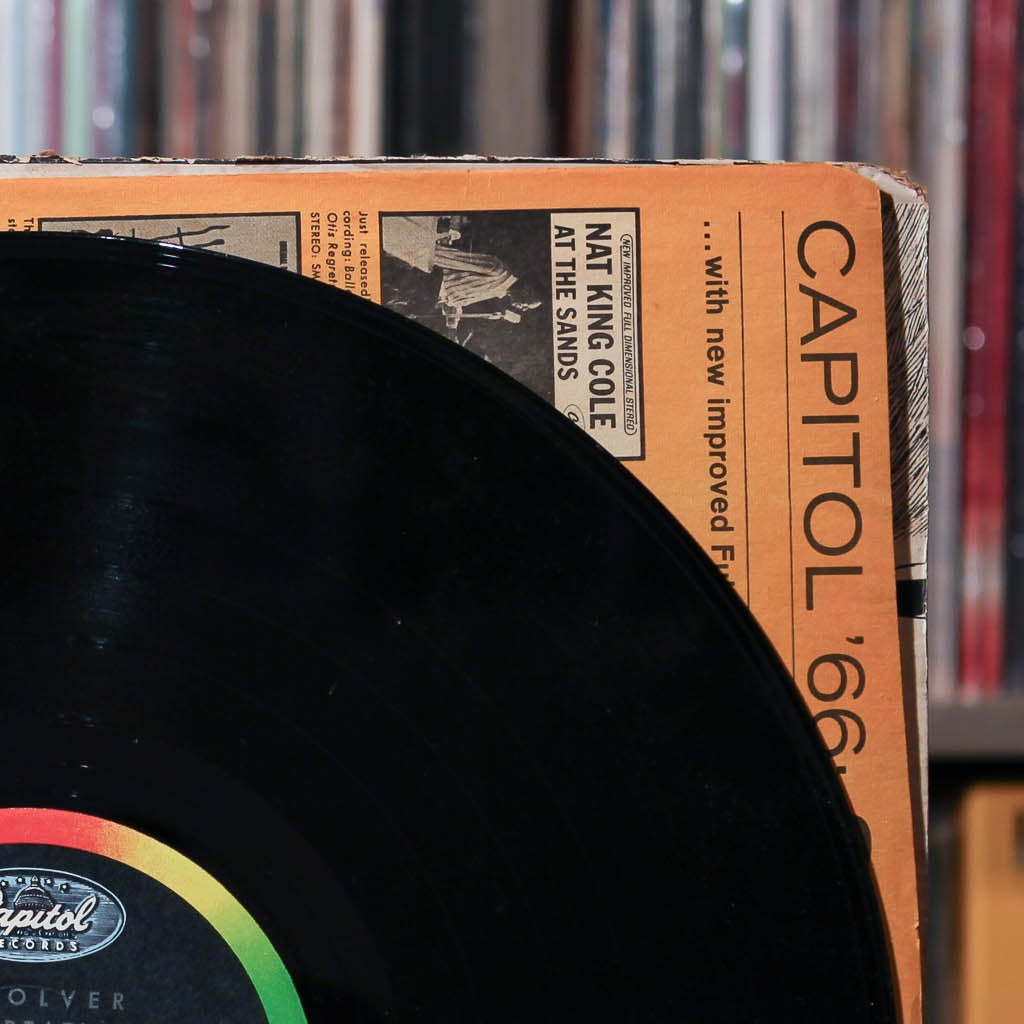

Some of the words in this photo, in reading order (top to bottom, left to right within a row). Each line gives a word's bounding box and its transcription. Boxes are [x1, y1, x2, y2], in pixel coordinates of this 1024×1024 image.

[327, 212, 338, 237] Otis
[341, 210, 354, 261] cording:
[358, 211, 368, 234] Just
[554, 225, 576, 251] AT
[360, 243, 371, 296] released
[585, 223, 613, 275] NAT
[622, 238, 631, 259] NEW
[555, 258, 576, 300] THE
[622, 259, 632, 307] IMPROVED
[586, 284, 614, 350] KING
[623, 310, 632, 331] FULL
[556, 307, 579, 381] SANDS
[624, 336, 634, 394] DIMENSIONAL
[706, 328, 726, 385] new
[588, 359, 616, 429] COLE
[625, 398, 635, 430] STEREO
[797, 219, 863, 611] CAPITOL
[703, 398, 734, 531] improved
